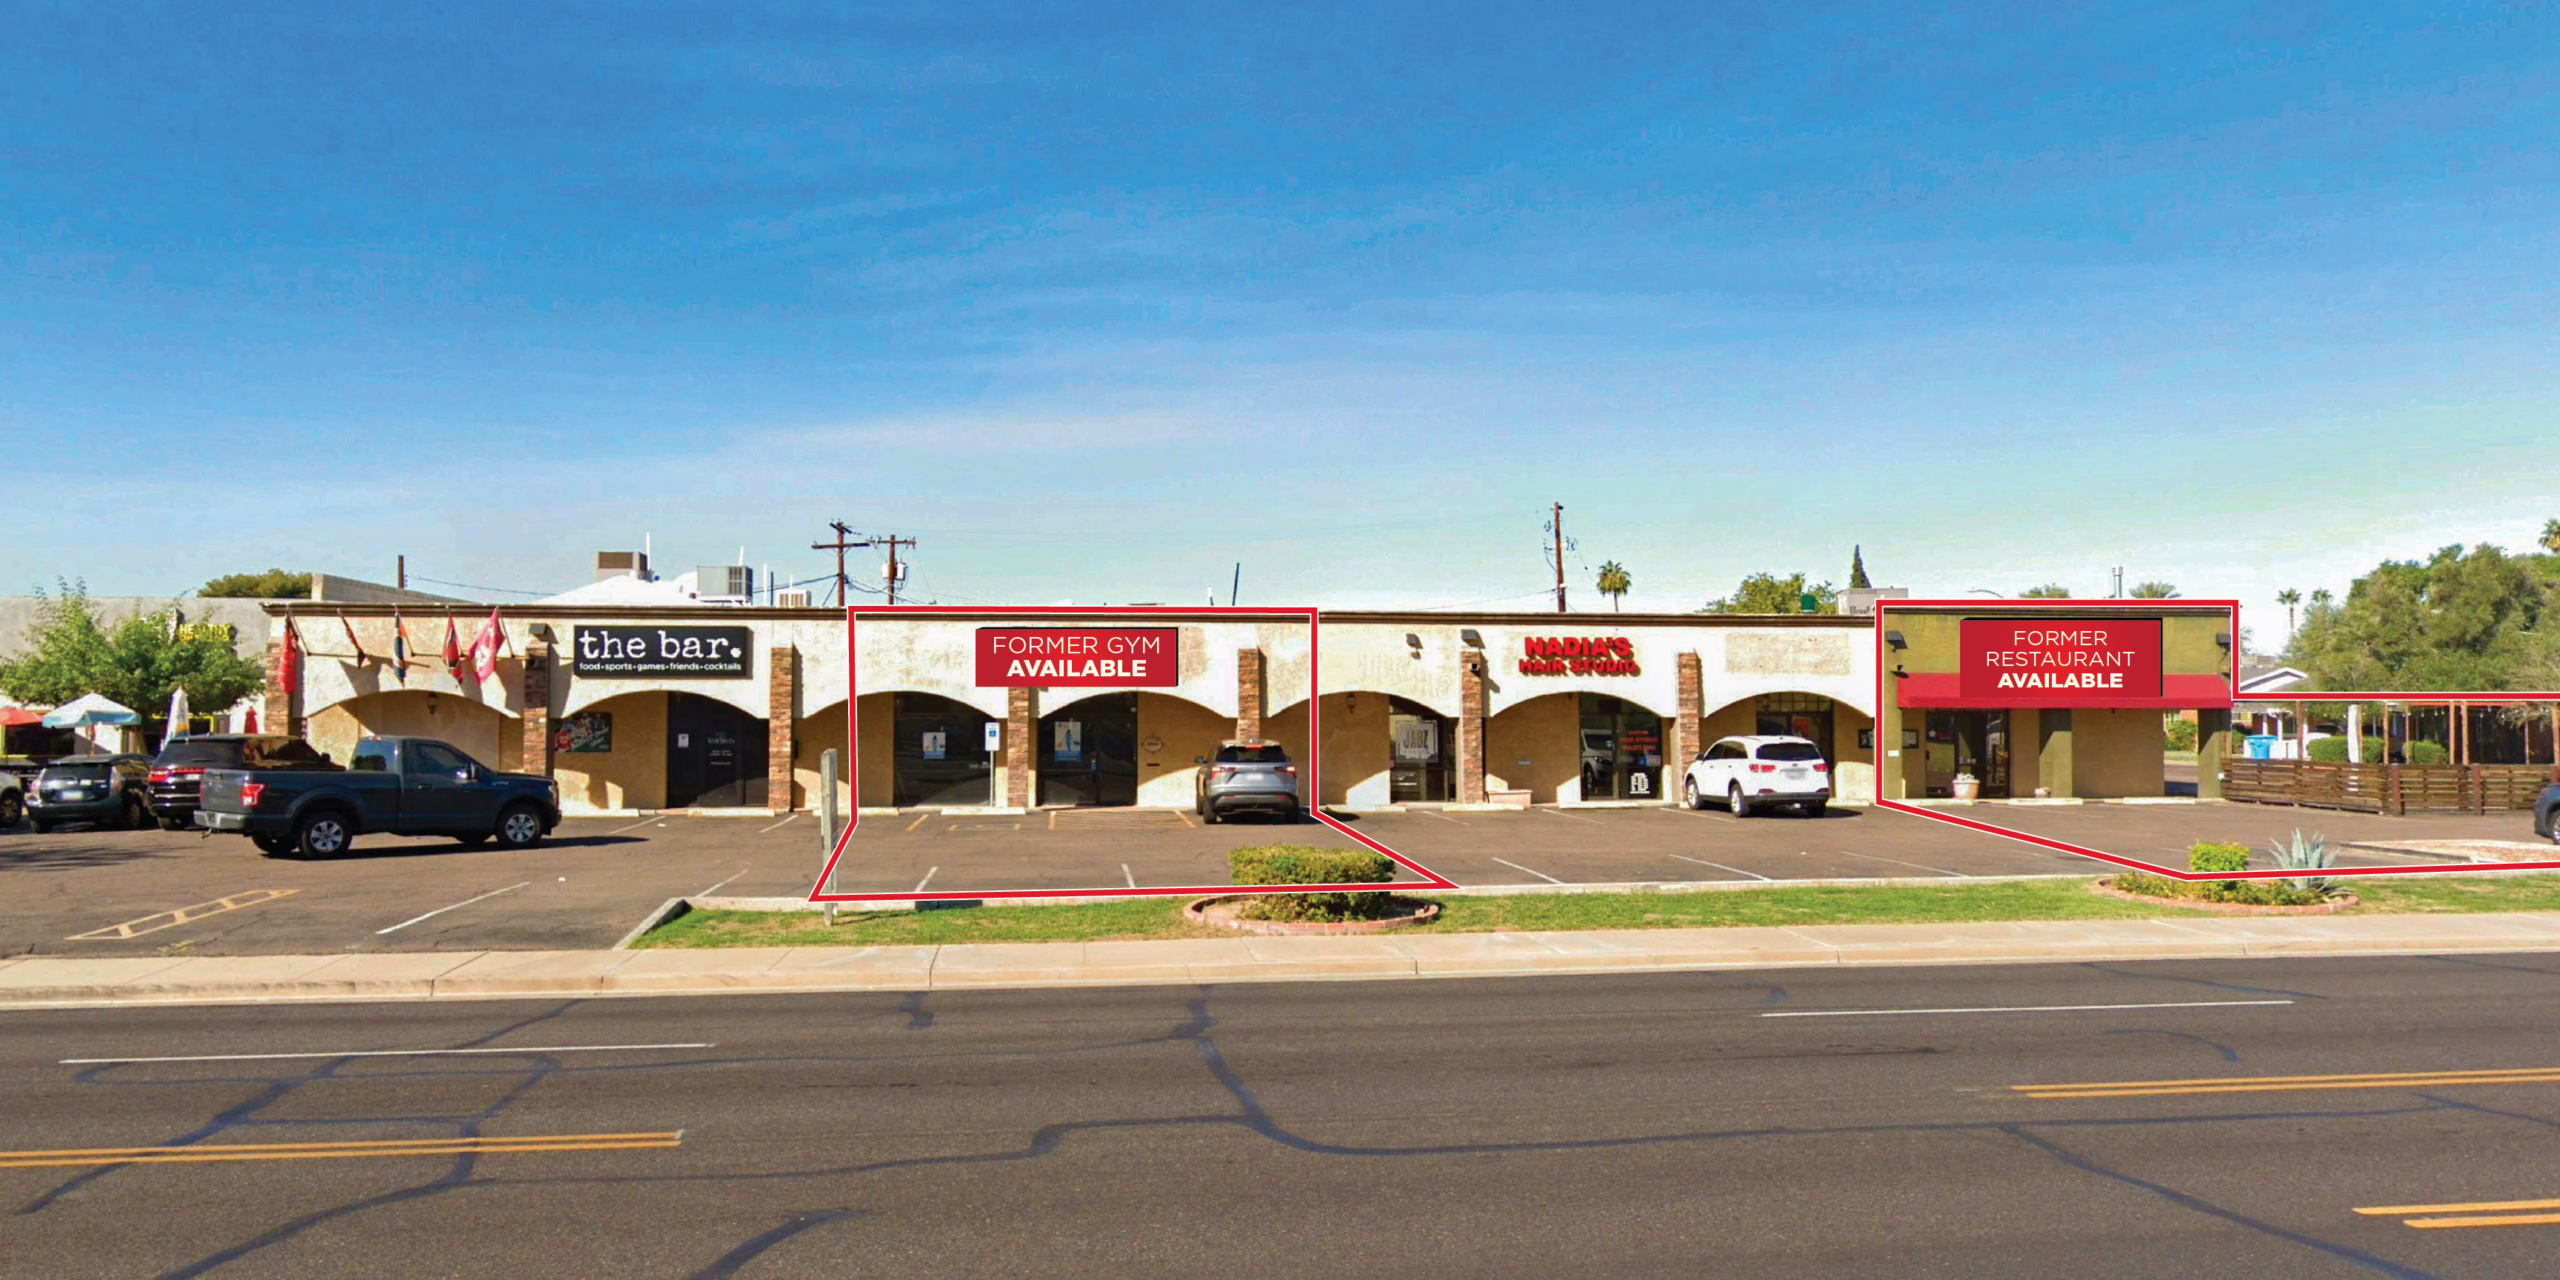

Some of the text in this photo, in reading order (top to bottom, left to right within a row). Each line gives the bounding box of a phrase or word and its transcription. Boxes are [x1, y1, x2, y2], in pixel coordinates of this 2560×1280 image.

[578, 629, 742, 659] the bar.
[1524, 636, 1632, 657] NADIA'S
[1519, 659, 1638, 673] HAIR STUDIO
[1403, 729, 1429, 749] JABZ
